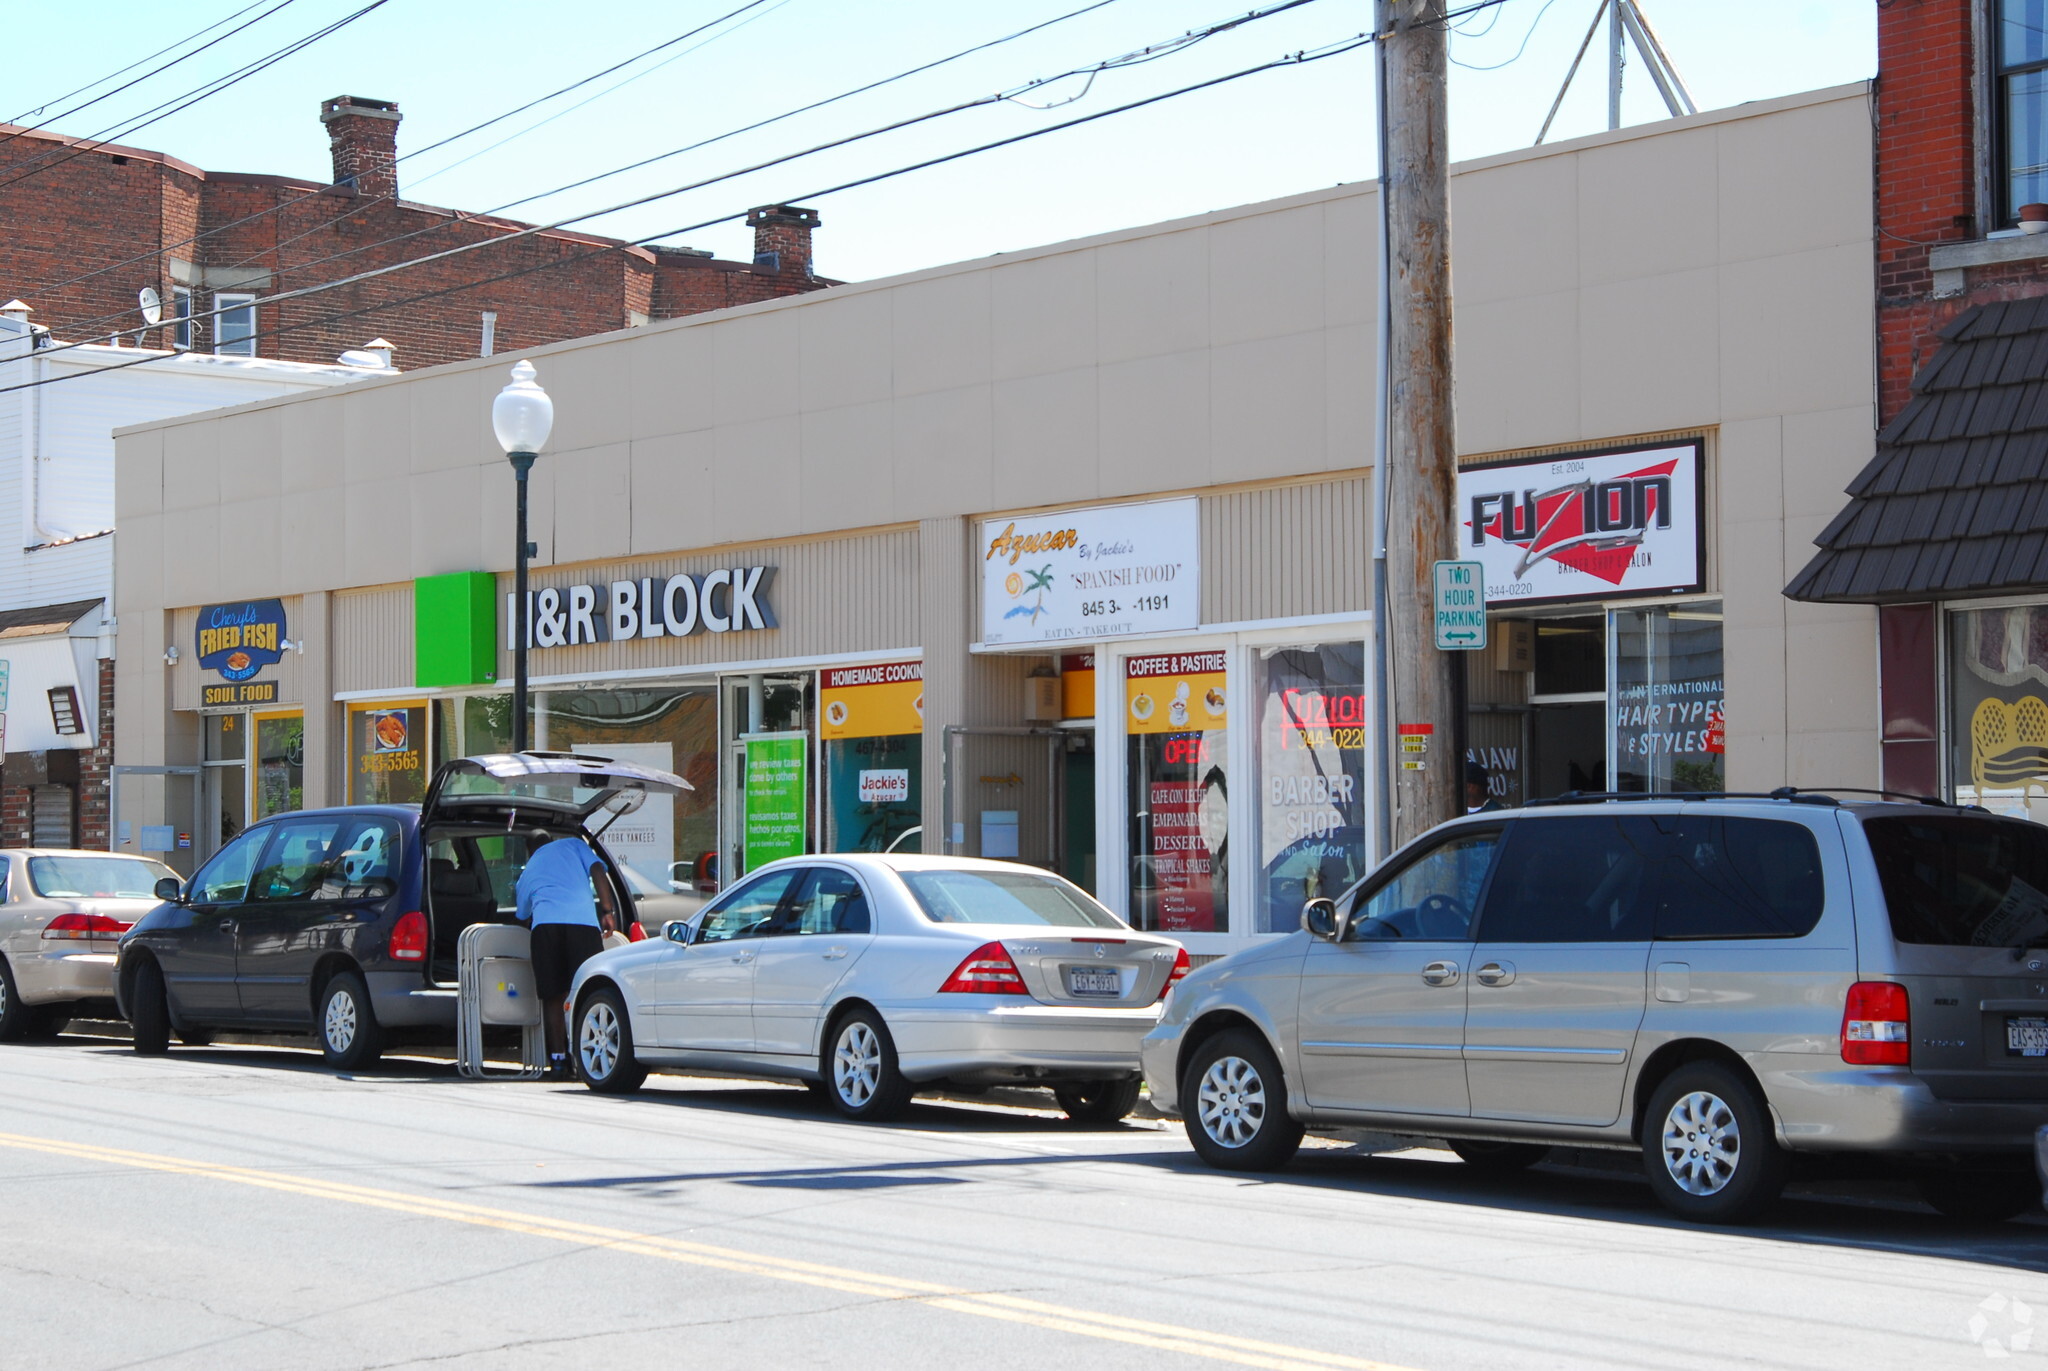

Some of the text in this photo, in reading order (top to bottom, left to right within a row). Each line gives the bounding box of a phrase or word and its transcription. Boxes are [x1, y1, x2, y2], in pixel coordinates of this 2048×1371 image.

[1551, 461, 1584, 475] Est. 2004
[986, 522, 1078, 566] Azucar
[1079, 538, 1134, 560] By Jackie's
[1558, 557, 1588, 574] BARBER
[1592, 555, 1614, 571] SHOP
[1626, 552, 1652, 568] SALON
[1448, 568, 1471, 584] TWO
[612, 566, 772, 642] BLOCK
[1445, 589, 1475, 606] HOUR
[1082, 601, 1105, 617] 845
[211, 605, 256, 635] Cheryl's
[1439, 610, 1482, 628] PARKING
[1044, 629, 1062, 639] EAT
[1063, 628, 1075, 637] IN
[1083, 625, 1109, 636] TAKE
[1110, 623, 1132, 633] OUT
[200, 623, 277, 659] FRIED FISH
[223, 665, 256, 680] 343-5565
[1129, 658, 1168, 676] COFFEE
[1171, 657, 1179, 673] &
[831, 667, 884, 687] HOMEMADE
[205, 684, 273, 704] SOUL FOOD
[222, 715, 235, 732] 24
[1617, 704, 1662, 727] HAIR
[1639, 729, 1710, 755] STYLES
[1164, 739, 1210, 764] OPEN
[360, 749, 418, 774] 343-5565
[759, 757, 783, 769] review
[784, 758, 802, 767] taxes
[749, 770, 798, 784] done by others
[861, 775, 906, 790] Jackie's
[1151, 788, 1207, 804] CAFE CON LECHE
[1271, 774, 1354, 806] BARBER
[749, 811, 797, 821] revisamos taxes
[1153, 812, 1209, 828] EMPANADAS
[1286, 810, 1342, 841] SHOP
[608, 833, 624, 843] YORK
[627, 832, 655, 843] YANKEES
[1154, 835, 1210, 851] DESSERTS
[1301, 838, 1345, 858] Salon
[1155, 858, 1211, 874] TROPICAL SHAKES
